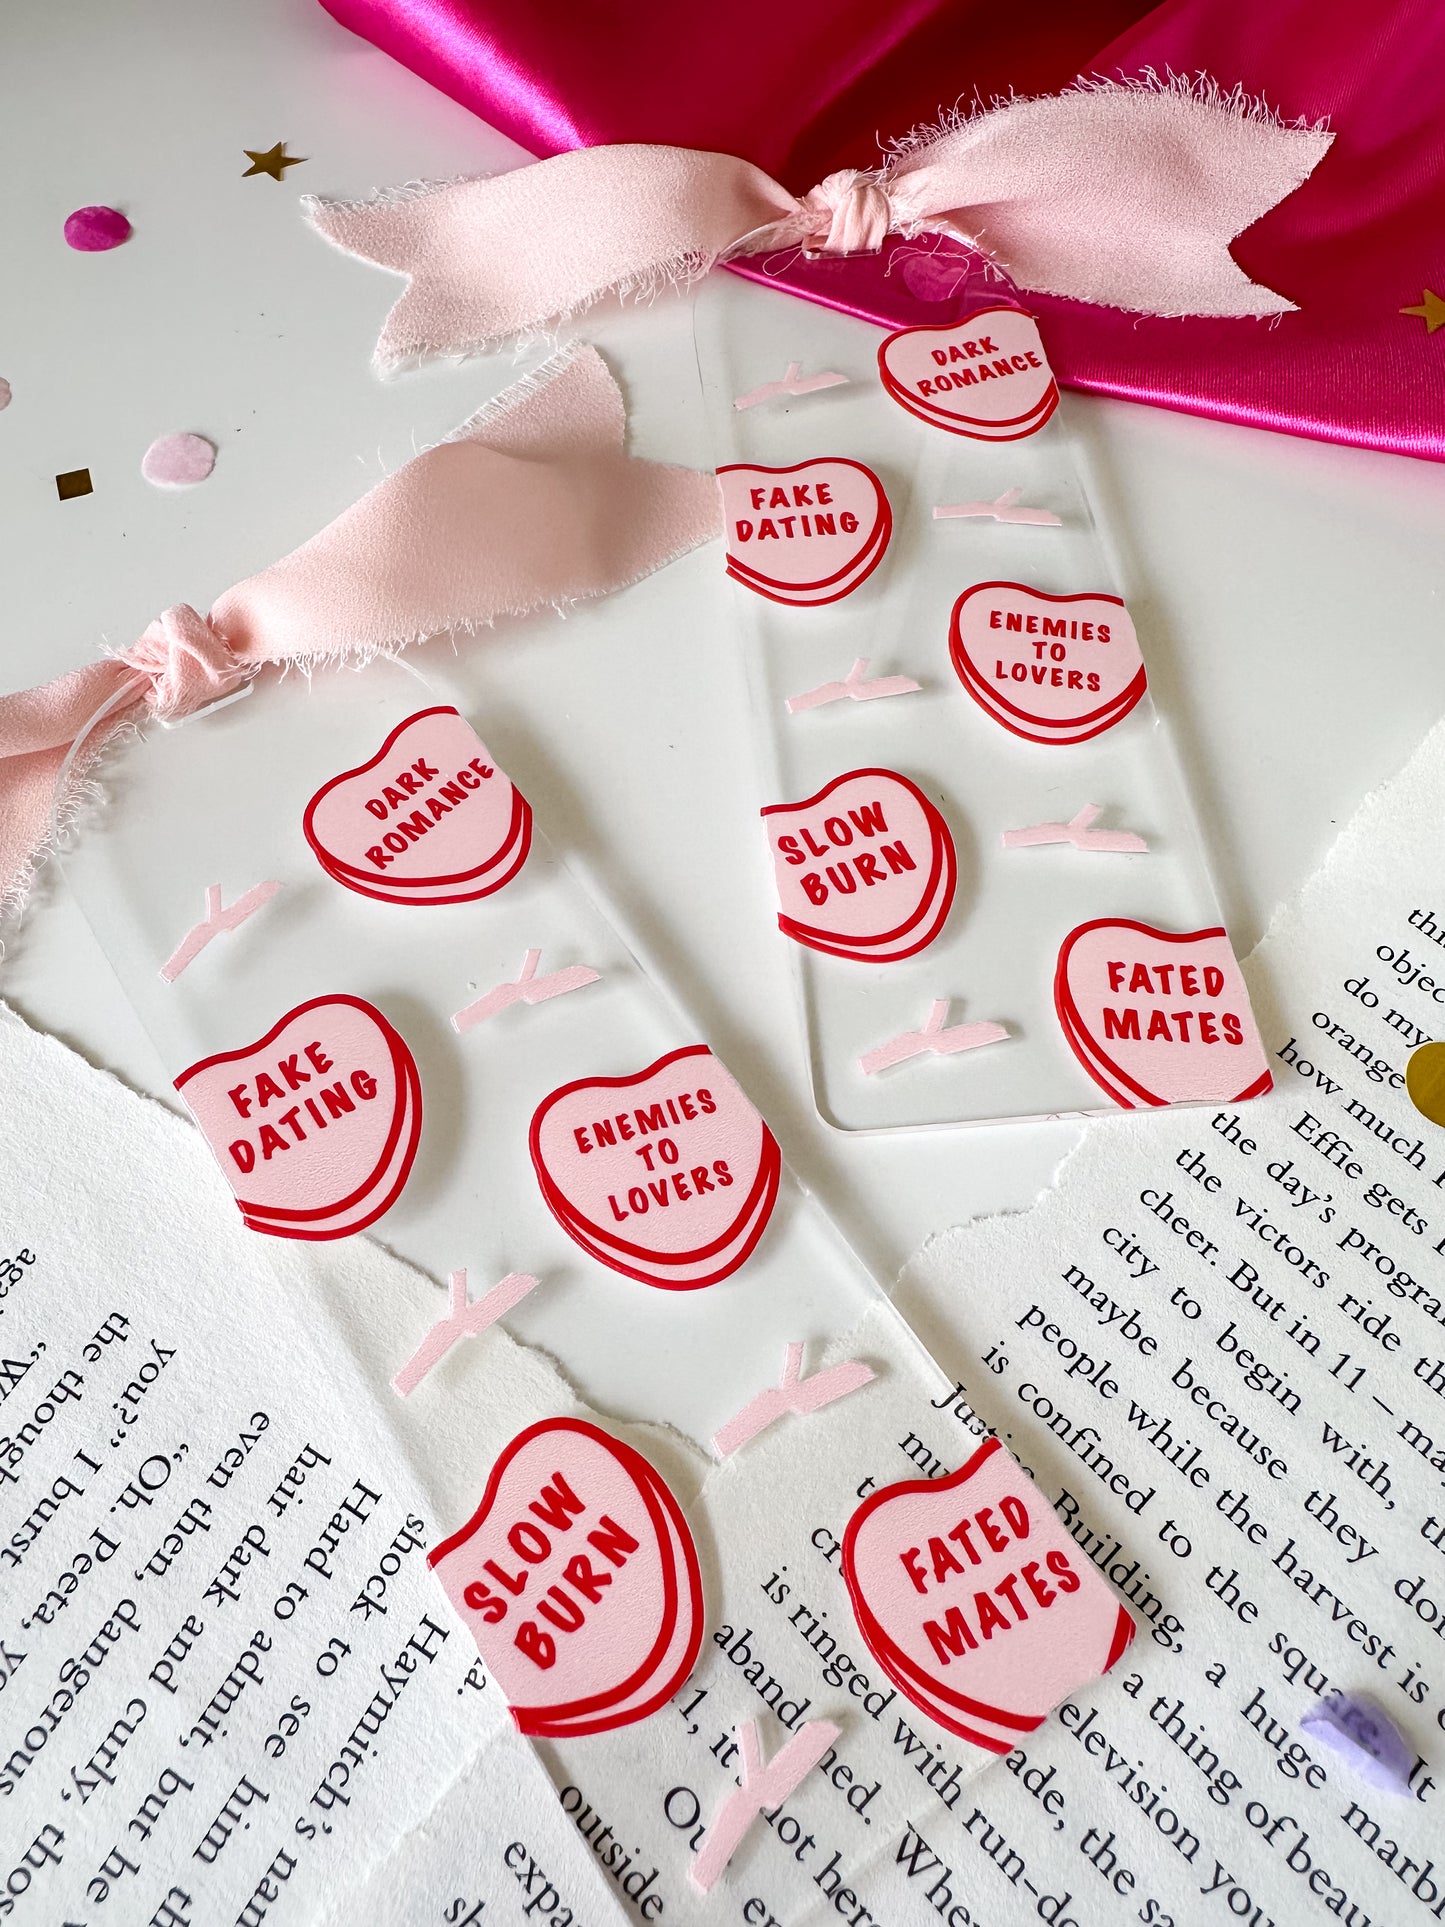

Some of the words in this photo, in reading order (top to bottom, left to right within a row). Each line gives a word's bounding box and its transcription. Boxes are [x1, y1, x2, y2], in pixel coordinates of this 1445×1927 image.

[917, 352, 1042, 397] ROMANCE
[931, 337, 999, 366] DARK
[736, 512, 859, 542] DATING
[751, 483, 833, 510] FAKE
[990, 611, 1110, 643] ENEMIES
[1032, 642, 1065, 661] TO
[996, 661, 1100, 691] LOVERS
[365, 758, 439, 820] DARK
[365, 758, 493, 869] ROMANCE
[778, 802, 888, 865] SLOW
[800, 841, 916, 905] BURN
[1108, 962, 1224, 997] FATED
[1344, 977, 1379, 1008] do
[1382, 1009, 1433, 1048] my
[1103, 1008, 1243, 1045] MATES
[1312, 1013, 1405, 1089] orange
[228, 1042, 333, 1118] FAKE
[574, 1089, 716, 1153] ENEMIES
[1276, 1038, 1343, 1095] how
[1341, 1099, 1426, 1171] much
[229, 1070, 377, 1173] DATING
[636, 1138, 678, 1171] TO
[608, 1161, 733, 1221] LOVERS
[1289, 1111, 1363, 1179] Effie
[1363, 1183, 1428, 1235] gets
[1176, 1149, 1222, 1193] the
[1236, 1197, 1330, 1288] victors
[1337, 1294, 1400, 1351] ride
[1211, 1111, 1256, 1155] the
[1267, 1160, 1336, 1223] day’s
[1336, 1227, 1445, 1327] progra
[1140, 1190, 1219, 1266] cheer.
[1226, 1258, 1287, 1321] But
[1286, 1315, 1320, 1357] in
[1328, 1353, 1366, 1393] 11
[83, 1312, 130, 1362] the
[1103, 1228, 1160, 1278] city
[1170, 1287, 1202, 1319] to
[1216, 1321, 1301, 1416] begin
[1322, 1421, 1395, 1510] with,
[206, 1412, 269, 1488] even
[1061, 1265, 1157, 1359] maybe
[1171, 1357, 1288, 1480] because
[1304, 1490, 1379, 1563] they
[73, 1448, 103, 1476] I
[266, 1443, 332, 1517] hair
[981, 1340, 1009, 1374] is
[1018, 1383, 1156, 1516] confined
[1159, 1520, 1192, 1558] to
[1205, 1566, 1258, 1624] the
[1, 1476, 85, 1568] burst
[134, 1498, 212, 1581] then,
[304, 1478, 382, 1580] Hard
[900, 1496, 1029, 1594] FATED
[1015, 1305, 1118, 1399] people
[1128, 1400, 1209, 1488] while
[1216, 1490, 1267, 1545] the
[1271, 1538, 1396, 1669] harvest
[1397, 1662, 1429, 1703] is
[21, 1523, 121, 1629] Peeta,
[202, 1525, 271, 1607] dark
[350, 1513, 426, 1625] shock
[464, 1472, 585, 1624] SLOW
[274, 1580, 309, 1620] to
[514, 1515, 639, 1670] BURN
[923, 1551, 1080, 1665] MATES
[148, 1615, 204, 1694] and
[179, 1630, 272, 1748] admit,
[316, 1638, 351, 1678] to
[761, 1566, 791, 1604] is
[788, 1604, 897, 1721] ringed
[894, 1717, 963, 1811] with
[0, 1599, 141, 1795] dangerous
[264, 1695, 311, 1758] see
[295, 1613, 450, 1840] Haymitch’s
[1205, 1663, 1226, 1688] a
[1240, 1687, 1326, 1789] huge
[61, 1698, 147, 1805] curly,
[1057, 1700, 1200, 1864] elevision
[1123, 1674, 1143, 1699] a
[1150, 1696, 1242, 1805] thing
[1245, 1802, 1298, 1847] of
[128, 1767, 195, 1842] but
[192, 1774, 270, 1864] him
[86, 1845, 141, 1904] he
[561, 1786, 663, 1919] outside
[1080, 1828, 1135, 1896] the
